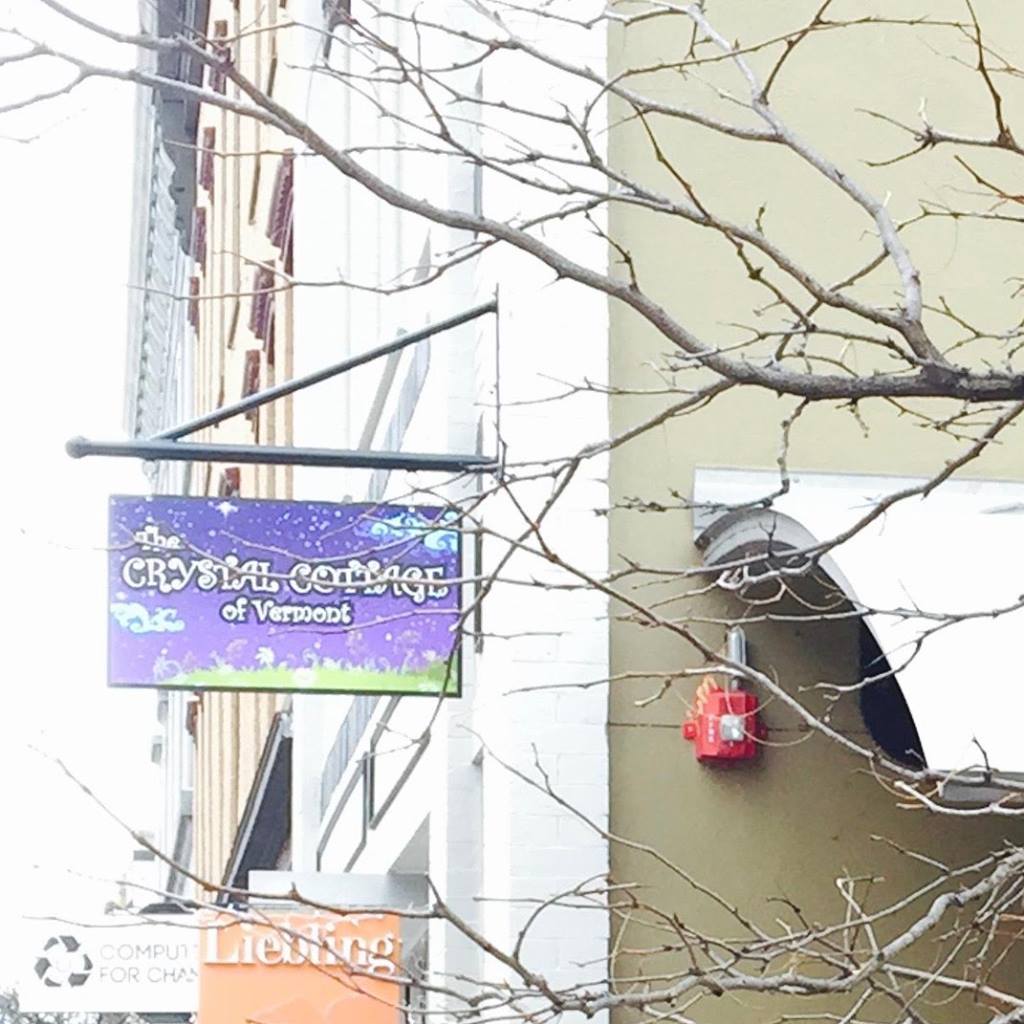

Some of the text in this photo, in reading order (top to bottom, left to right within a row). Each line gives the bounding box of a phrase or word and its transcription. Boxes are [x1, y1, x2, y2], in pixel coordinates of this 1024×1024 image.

[133, 526, 181, 551] The
[121, 555, 449, 603] CRYSTAL COTTAGE
[221, 597, 352, 624] of Vermont
[204, 921, 397, 976] Liebling
[99, 967, 140, 983] FOR
